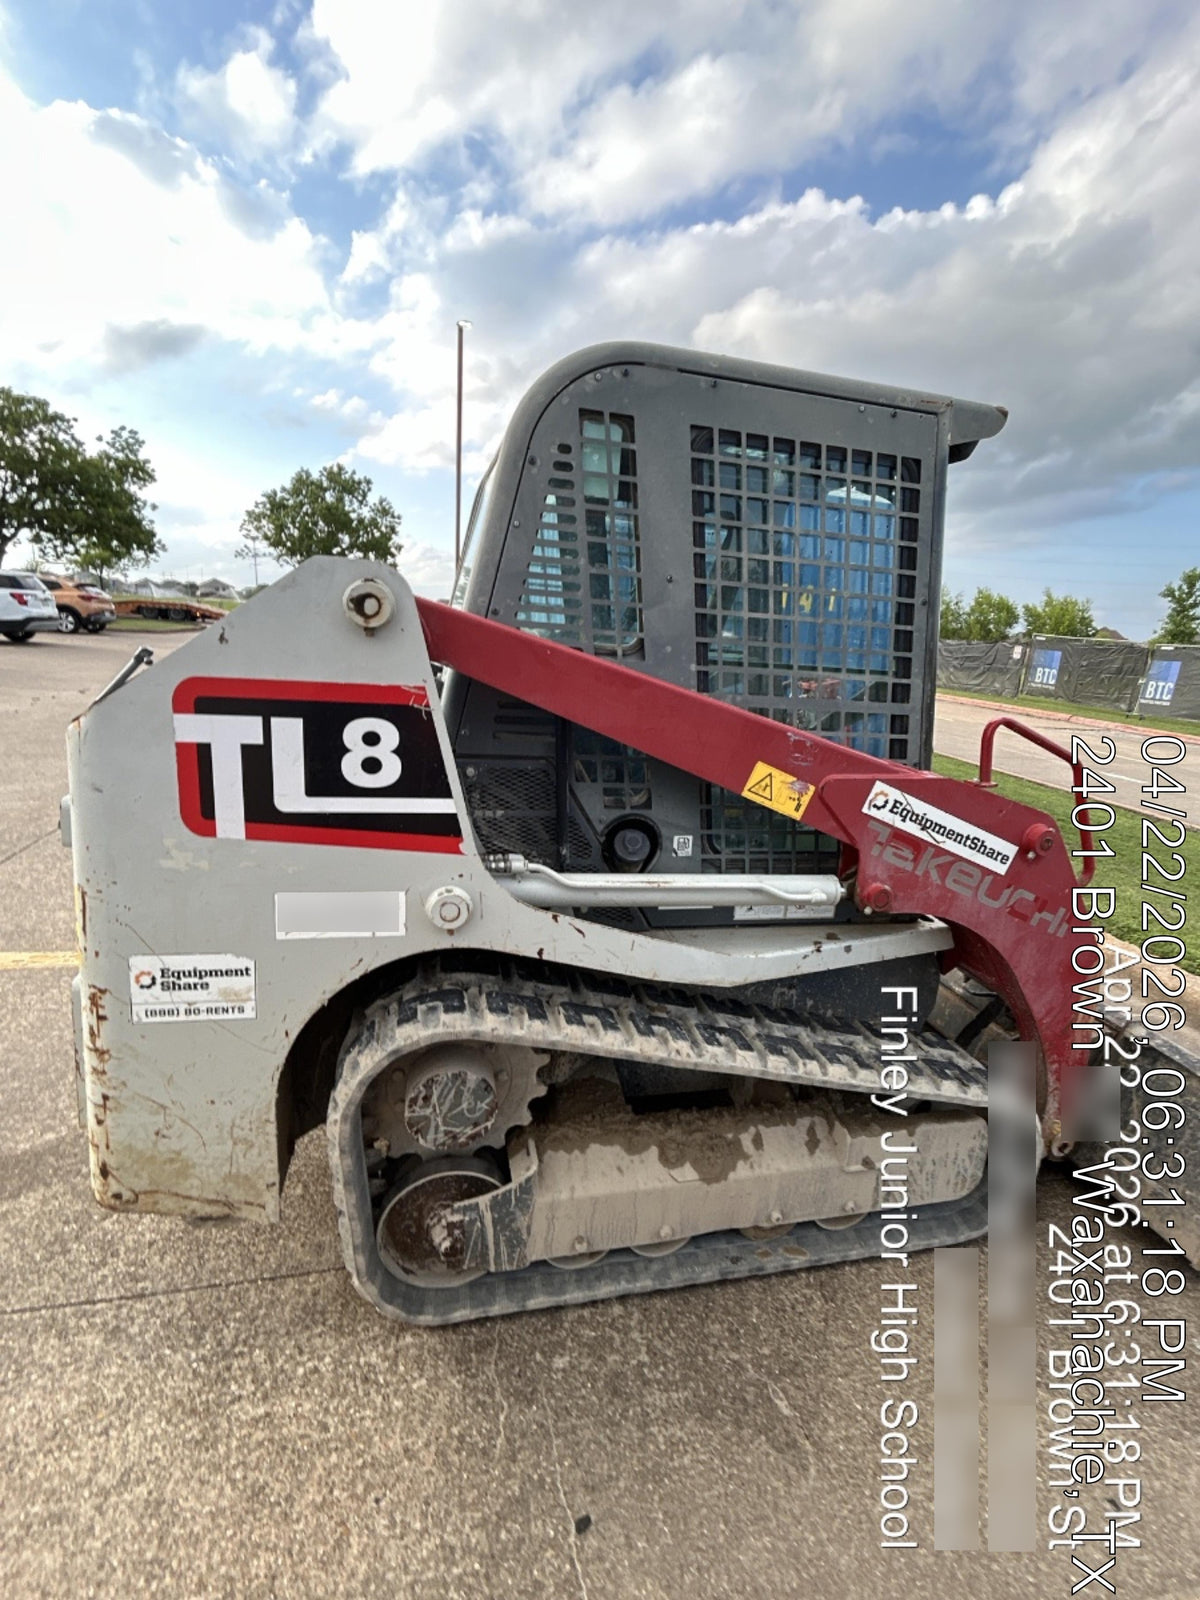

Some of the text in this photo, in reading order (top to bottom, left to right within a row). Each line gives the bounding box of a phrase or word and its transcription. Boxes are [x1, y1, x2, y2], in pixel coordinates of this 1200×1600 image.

[1034, 667, 1057, 684] BTC
[1145, 681, 1174, 700] BTC
[173, 714, 458, 840] TL8
[888, 798, 1011, 866] EquipmentShare
[159, 967, 252, 981] Equipment
[159, 980, 210, 992] Share
[144, 1007, 181, 1018] (888)
